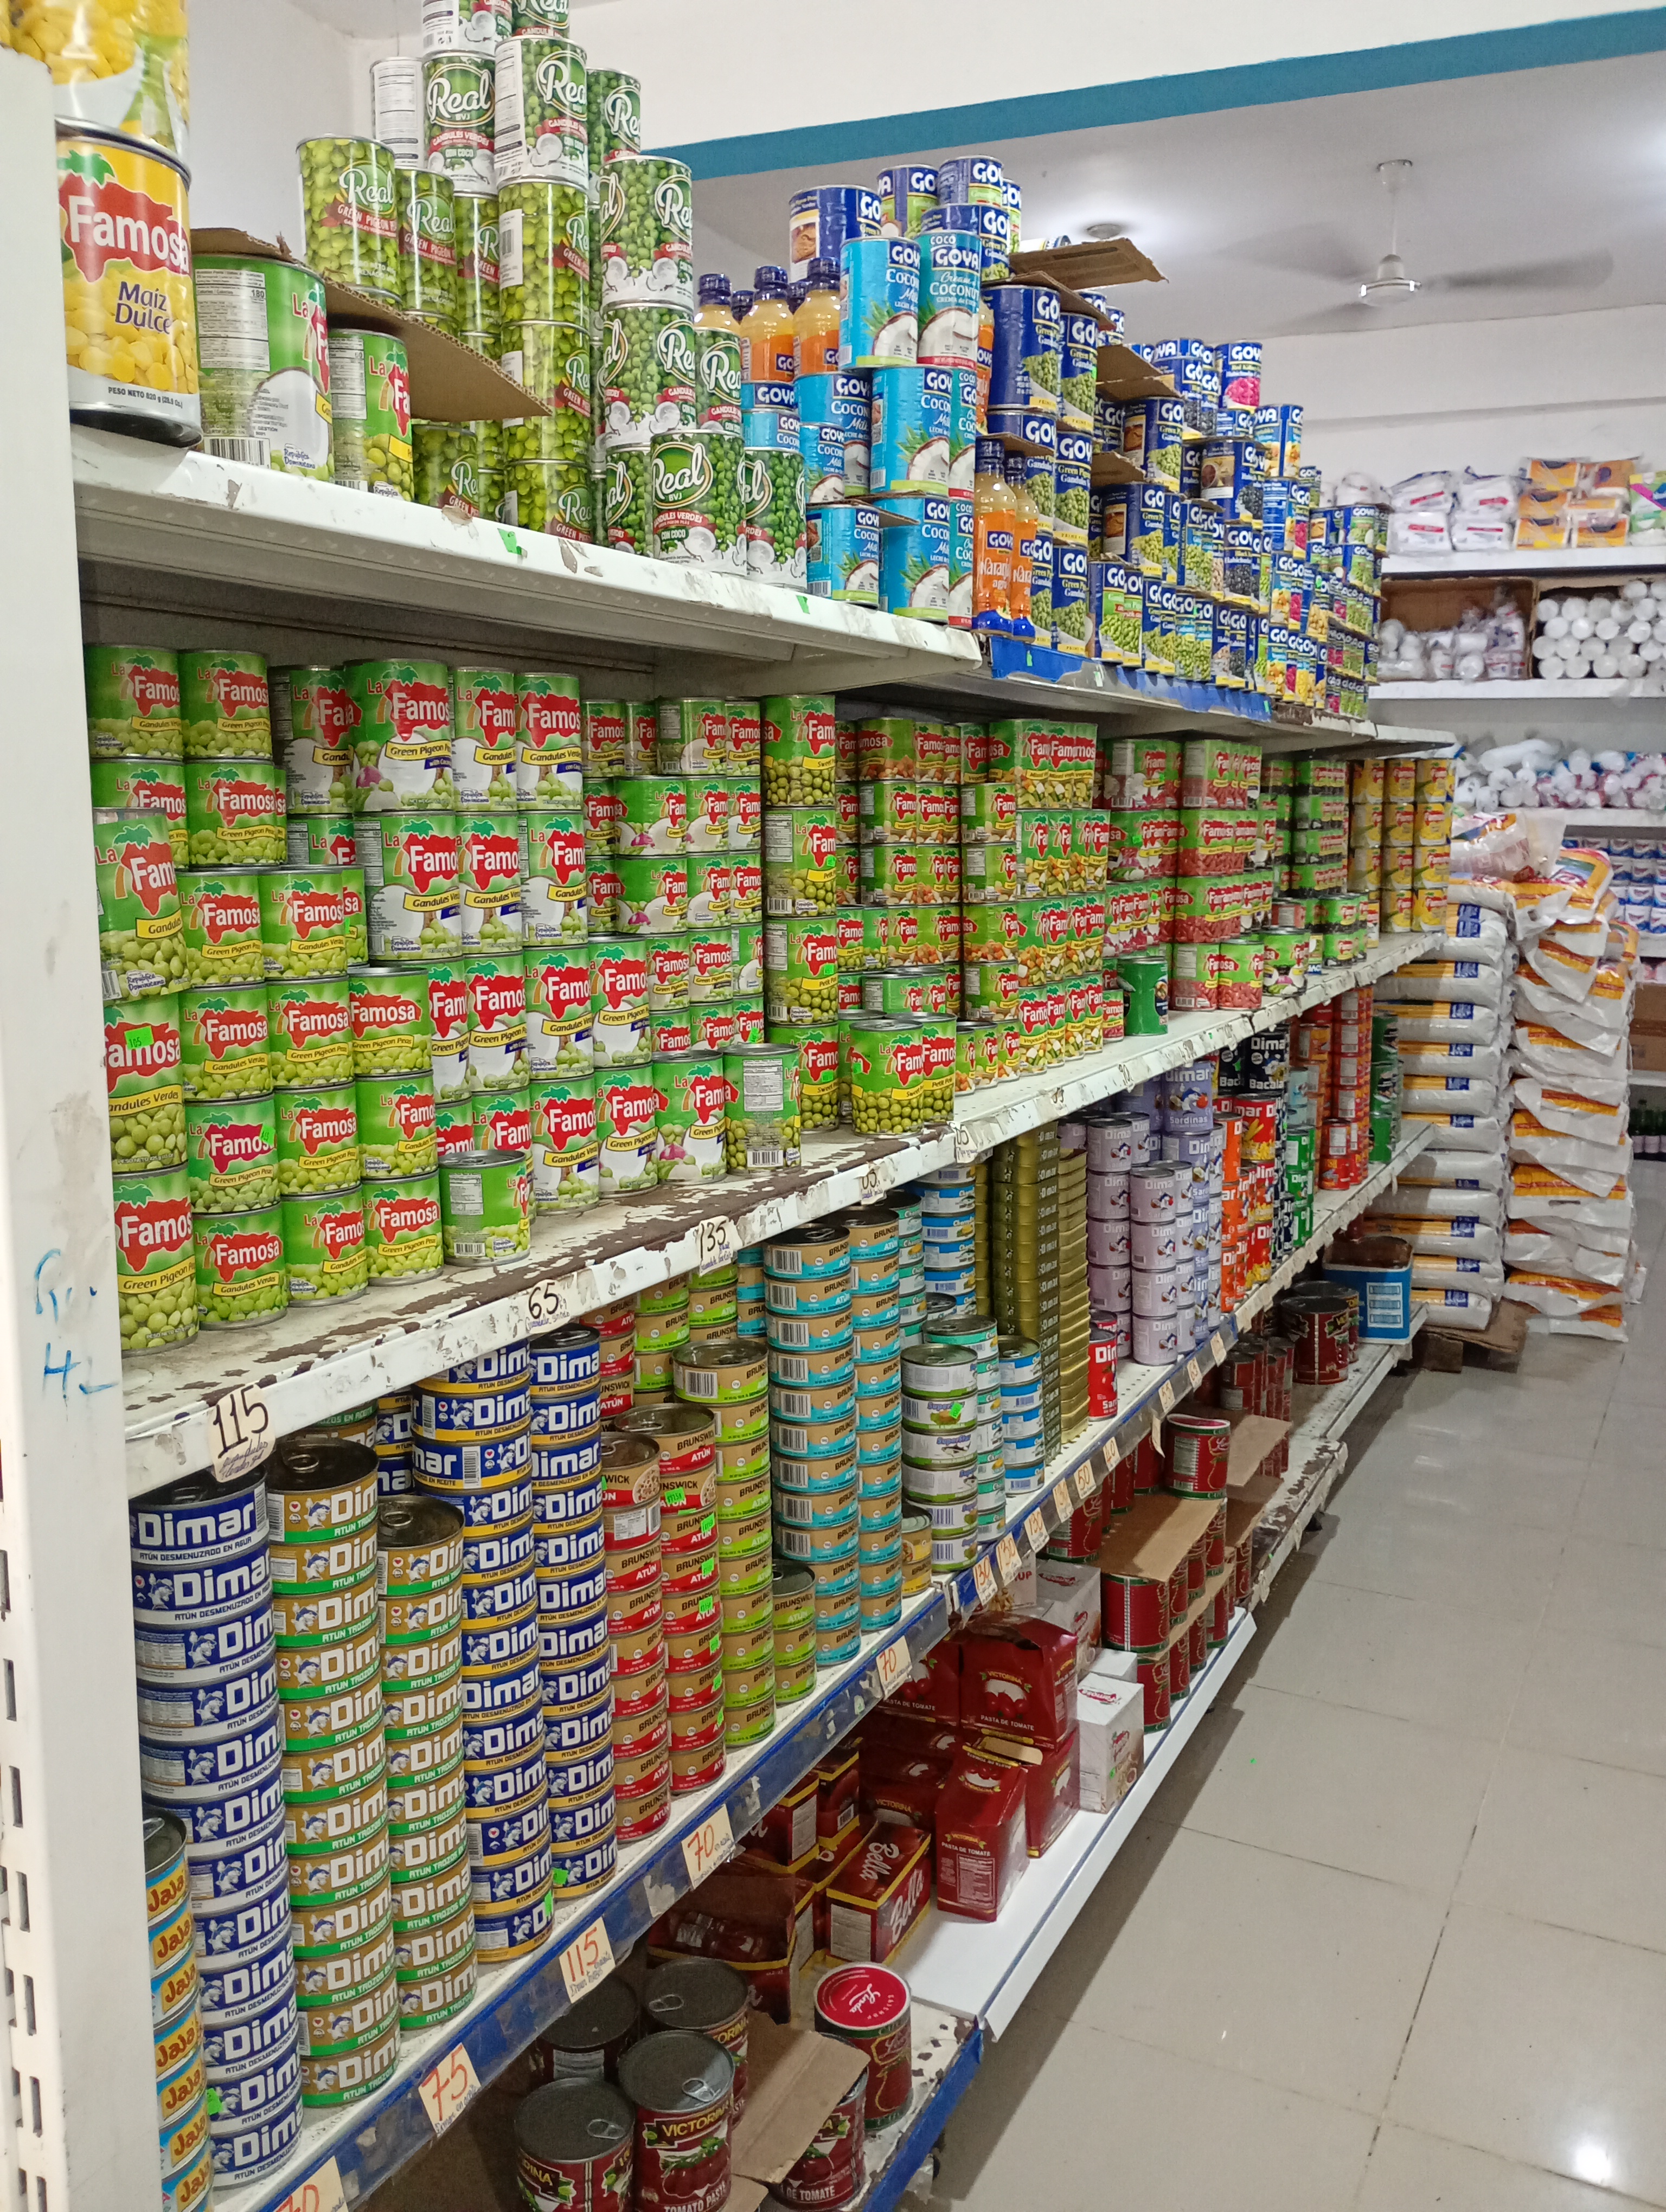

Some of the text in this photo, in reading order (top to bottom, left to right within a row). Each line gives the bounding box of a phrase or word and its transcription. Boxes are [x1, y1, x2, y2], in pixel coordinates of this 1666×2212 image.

[427, 69, 493, 119] Real
[339, 169, 394, 206] Real
[407, 199, 454, 233] Real
[67, 195, 189, 273] Famosa
[930, 235, 956, 245] COCO
[935, 248, 978, 266] GOYA
[119, 281, 168, 312] Maíz
[292, 293, 309, 318] La
[115, 304, 173, 336] Dulce
[368, 356, 386, 376] La
[108, 387, 125, 396] PESO
[127, 389, 144, 398] NETO
[653, 442, 704, 497] Real
[668, 493, 683, 501] BVJ
[677, 511, 703, 526] VERDES
[197, 667, 212, 680] La
[293, 686, 309, 700] La
[367, 679, 383, 695] La
[457, 686, 474, 702] La
[222, 721, 243, 729] Green
[390, 744, 444, 758] Green Pigeon
[482, 751, 512, 761] Gandules
[529, 751, 567, 761] Gandules
[198, 778, 211, 789] La
[218, 788, 276, 811] Famosa
[221, 827, 265, 838] Green Pigeon
[530, 828, 545, 843] La
[311, 835, 328, 849] La
[385, 832, 400, 848] La
[94, 847, 117, 865] La
[181, 893, 195, 905] La
[272, 891, 285, 902] La
[473, 894, 510, 905] Gandules
[555, 889, 582, 899] Gandules
[412, 896, 450, 908] Gandules
[298, 941, 329, 951] Gandules
[790, 934, 802, 944] La
[206, 947, 229, 955] Green
[525, 966, 539, 979] La
[268, 1000, 281, 1012] La
[350, 1000, 416, 1023] Famosa
[184, 1008, 198, 1021] La
[289, 1009, 348, 1031] Famosa
[601, 1007, 647, 1022] Green Pigeon
[206, 1019, 268, 1042] Famosa
[549, 1018, 582, 1032] Gandules
[369, 1037, 413, 1050] Pigeon Peas
[473, 1033, 496, 1045] Green
[290, 1047, 336, 1060] Green Pigeon
[880, 1043, 891, 1054] La
[212, 1060, 247, 1071] Gandules
[675, 1076, 689, 1089] La
[153, 1091, 179, 1102] Verdes
[380, 1094, 394, 1107] La
[281, 1108, 293, 1120] La
[189, 1123, 203, 1136] La
[693, 1127, 710, 1137] Green
[610, 1134, 652, 1149] Green Pigeon
[303, 1157, 325, 1166] Green
[552, 1149, 584, 1165] Gandules
[214, 1171, 260, 1184] Green Pigeon
[304, 1213, 318, 1227] La
[380, 1203, 438, 1227] Famosa
[195, 1233, 208, 1245] La
[701, 1220, 727, 1259] 135
[215, 1239, 280, 1266] Famosa
[382, 1239, 425, 1254] Green Pigeon
[123, 1266, 188, 1290] Green Pigeon
[220, 1275, 277, 1294] Gandules Verdes
[529, 1282, 559, 1319] 65
[601, 1398, 624, 1410] ATÚN
[213, 1384, 268, 1459] 115
[691, 1447, 712, 1463] ATÚN
[437, 1478, 456, 1487] ACEITE
[1078, 1465, 1090, 1489] 50
[138, 1501, 254, 1548] Dimar
[334, 1521, 356, 1536] ATUN
[139, 1536, 252, 1561] ATÚN DESMENUZADO EN AGUA
[636, 1564, 657, 1580] ATÚN
[975, 1557, 990, 1590] 130
[332, 1576, 354, 1589] ATUN
[175, 1594, 254, 1622] ATÚN DESMENUZADO
[322, 1624, 347, 1643] ATUN
[219, 1661, 240, 1674] ATÚN
[878, 1647, 897, 1682] 70
[411, 1677, 433, 1688] ATUN
[988, 1670, 1024, 1684] VICTORINA
[325, 1680, 349, 1695] ATUN
[912, 1702, 937, 1711] TOMATE
[980, 1714, 999, 1725] PASTA
[1010, 1721, 1035, 1731] TOMATE
[407, 1726, 429, 1737] ATUN
[688, 1824, 714, 1872] 70
[409, 1854, 458, 1879] ATUN TROZOS
[859, 1842, 900, 1881] Bella
[407, 1918, 431, 1930] ATUN
[567, 1927, 599, 1982] 115
[331, 1989, 356, 2003] ATUN
[225, 2005, 246, 2018] ATÚN
[420, 2044, 468, 2121] 75
[343, 2085, 366, 2100] ATUN
[800, 2185, 836, 2201] TOMATE
